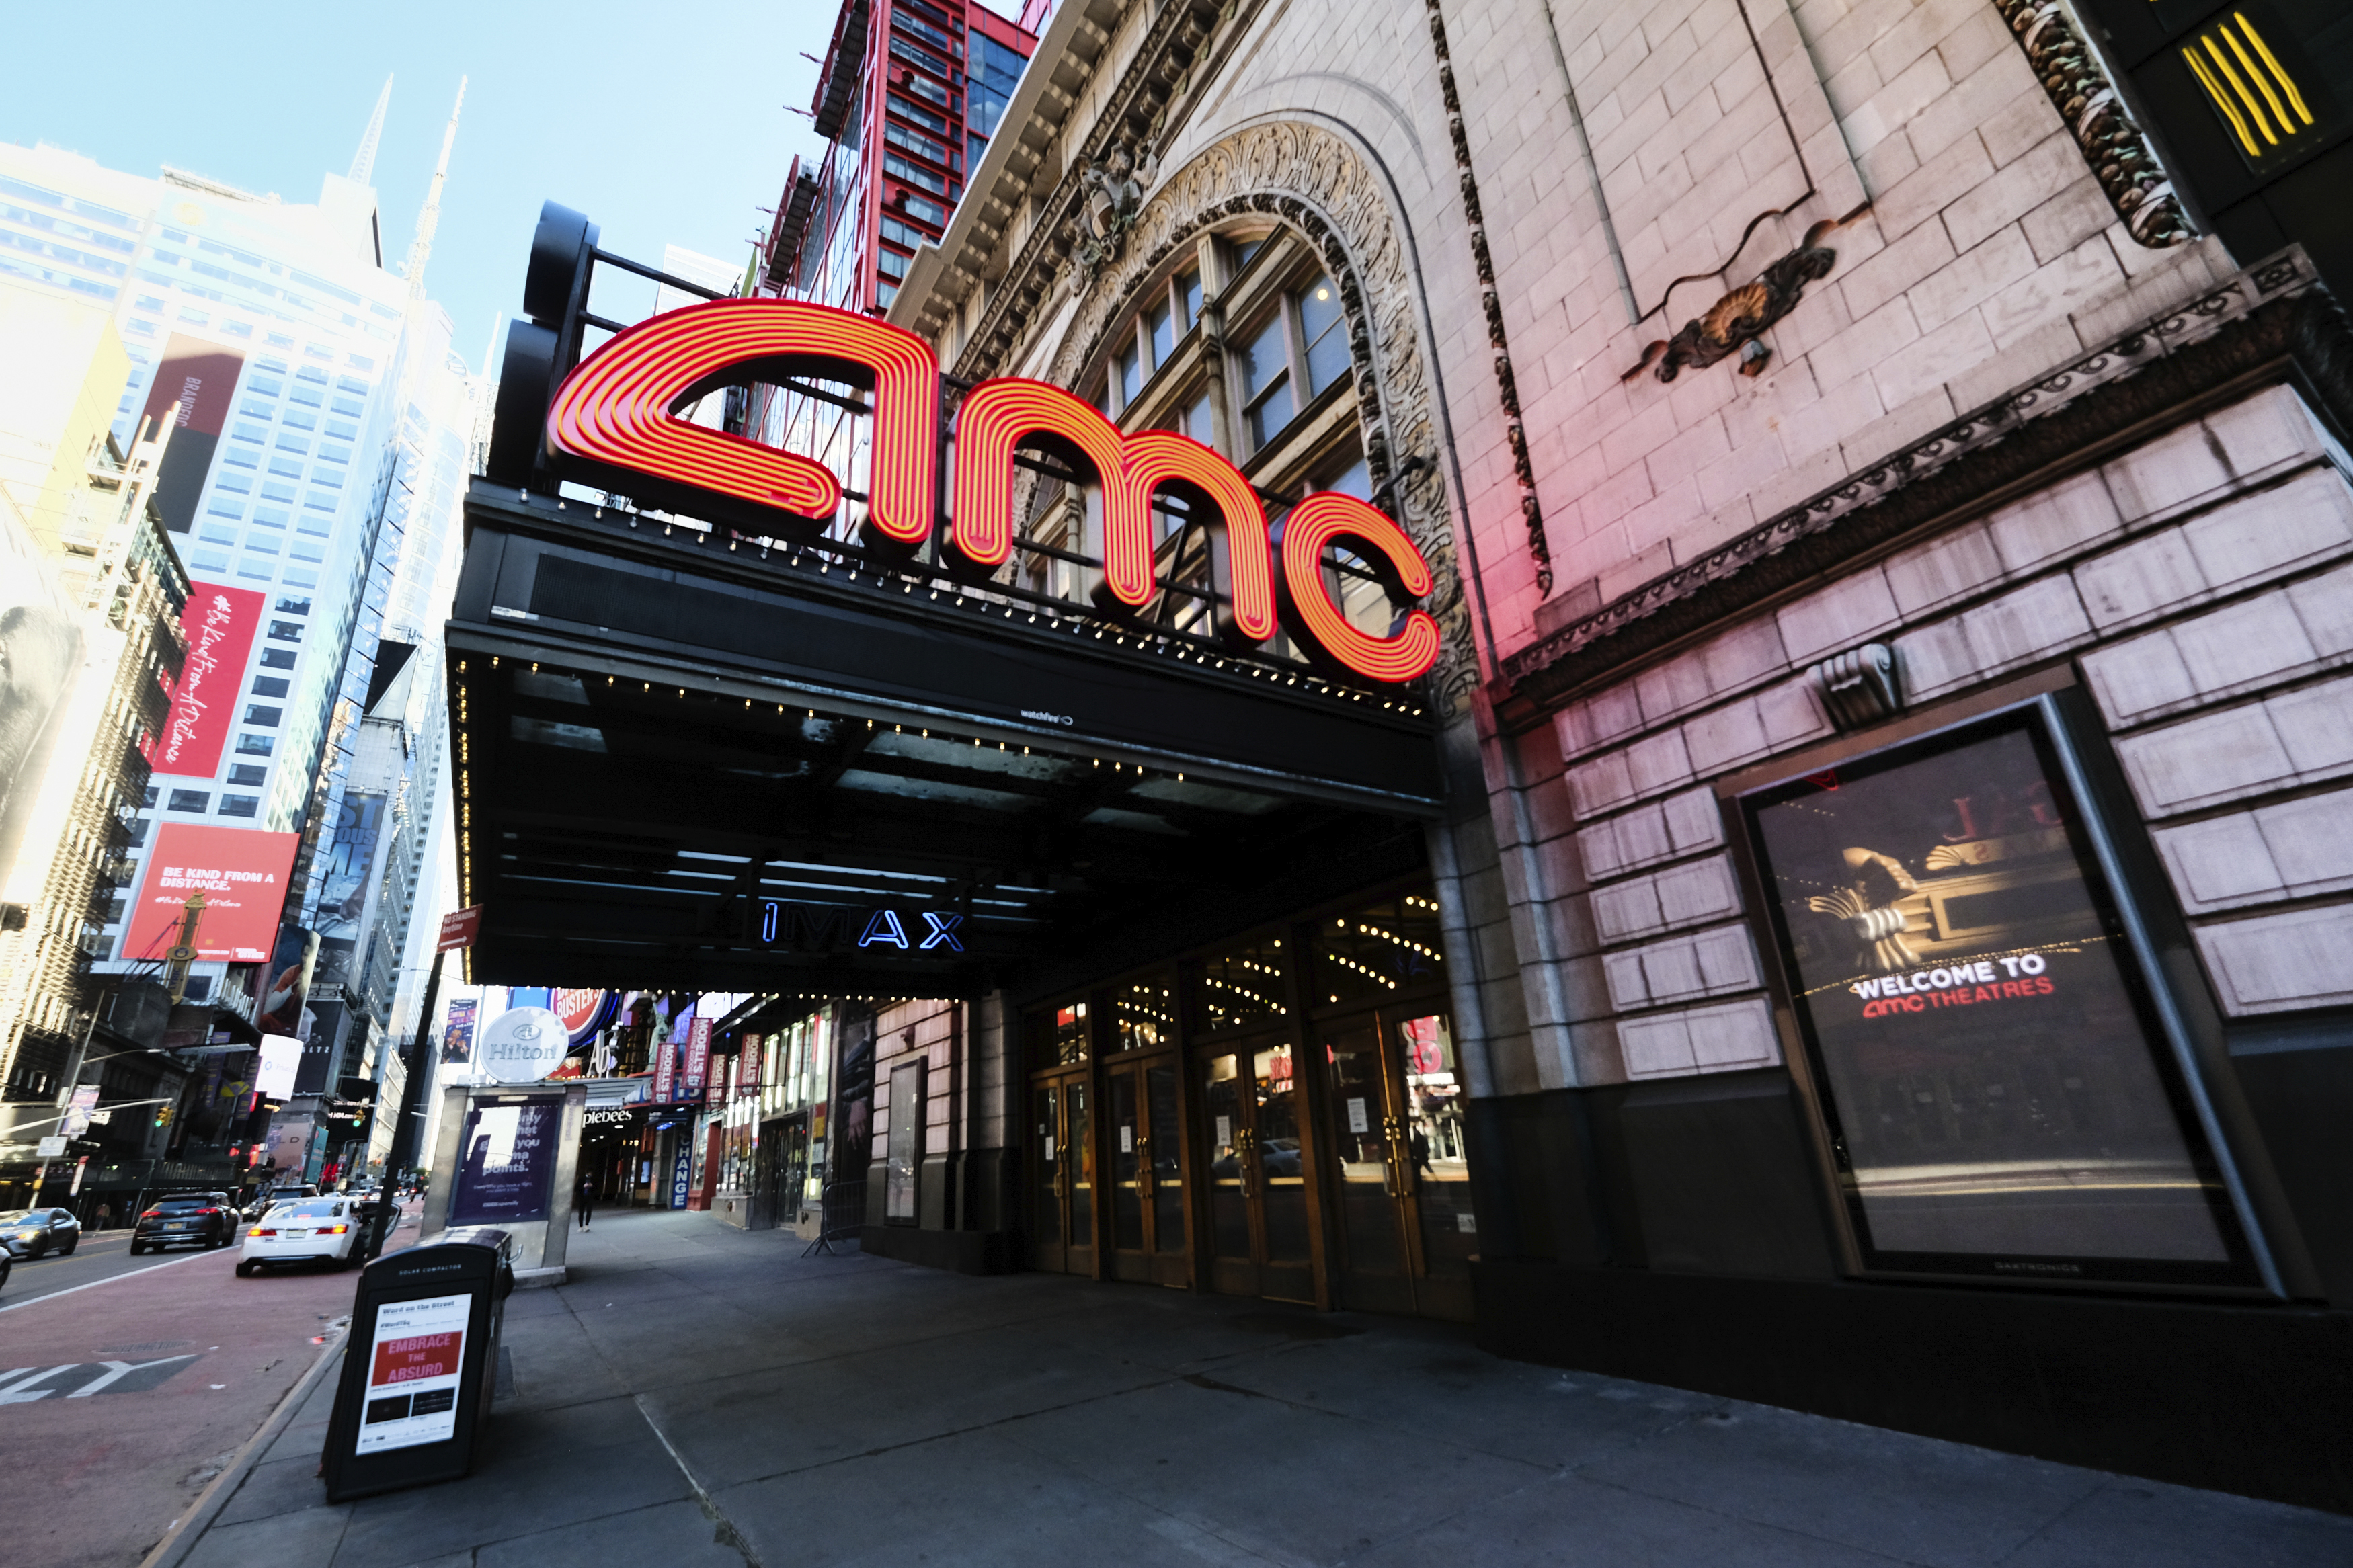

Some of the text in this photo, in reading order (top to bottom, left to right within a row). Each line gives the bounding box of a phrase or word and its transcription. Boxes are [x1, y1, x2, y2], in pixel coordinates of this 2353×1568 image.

[547, 297, 1440, 681] amc
[1020, 710, 1060, 723] watchfire
[334, 827, 377, 845] OUS
[163, 866, 274, 883] BE KIND FROM A
[160, 877, 231, 891] DISTANCE.
[444, 909, 477, 925] NO STANDING
[762, 902, 965, 952] IMAX
[1853, 954, 2046, 999] WELCOME TO
[1863, 976, 2055, 1018] amc THEATRES
[489, 1044, 557, 1060] Hilton
[692, 1018, 709, 1074] MODELL'S
[660, 1044, 674, 1092] MODELL'S
[746, 1034, 760, 1084] MODELL'S
[518, 1113, 541, 1124] nly
[582, 1110, 633, 1128] plebees
[516, 1125, 538, 1135] hat
[516, 1139, 541, 1149] you
[399, 1264, 463, 1276] SOLAR COMPACTOR
[383, 1307, 403, 1315] Word
[431, 1301, 455, 1309] Street
[388, 1333, 451, 1355] EMBRACE
[408, 1352, 426, 1363] THE
[0, 1354, 197, 1406] LY
[387, 1362, 443, 1383] ABSURD
